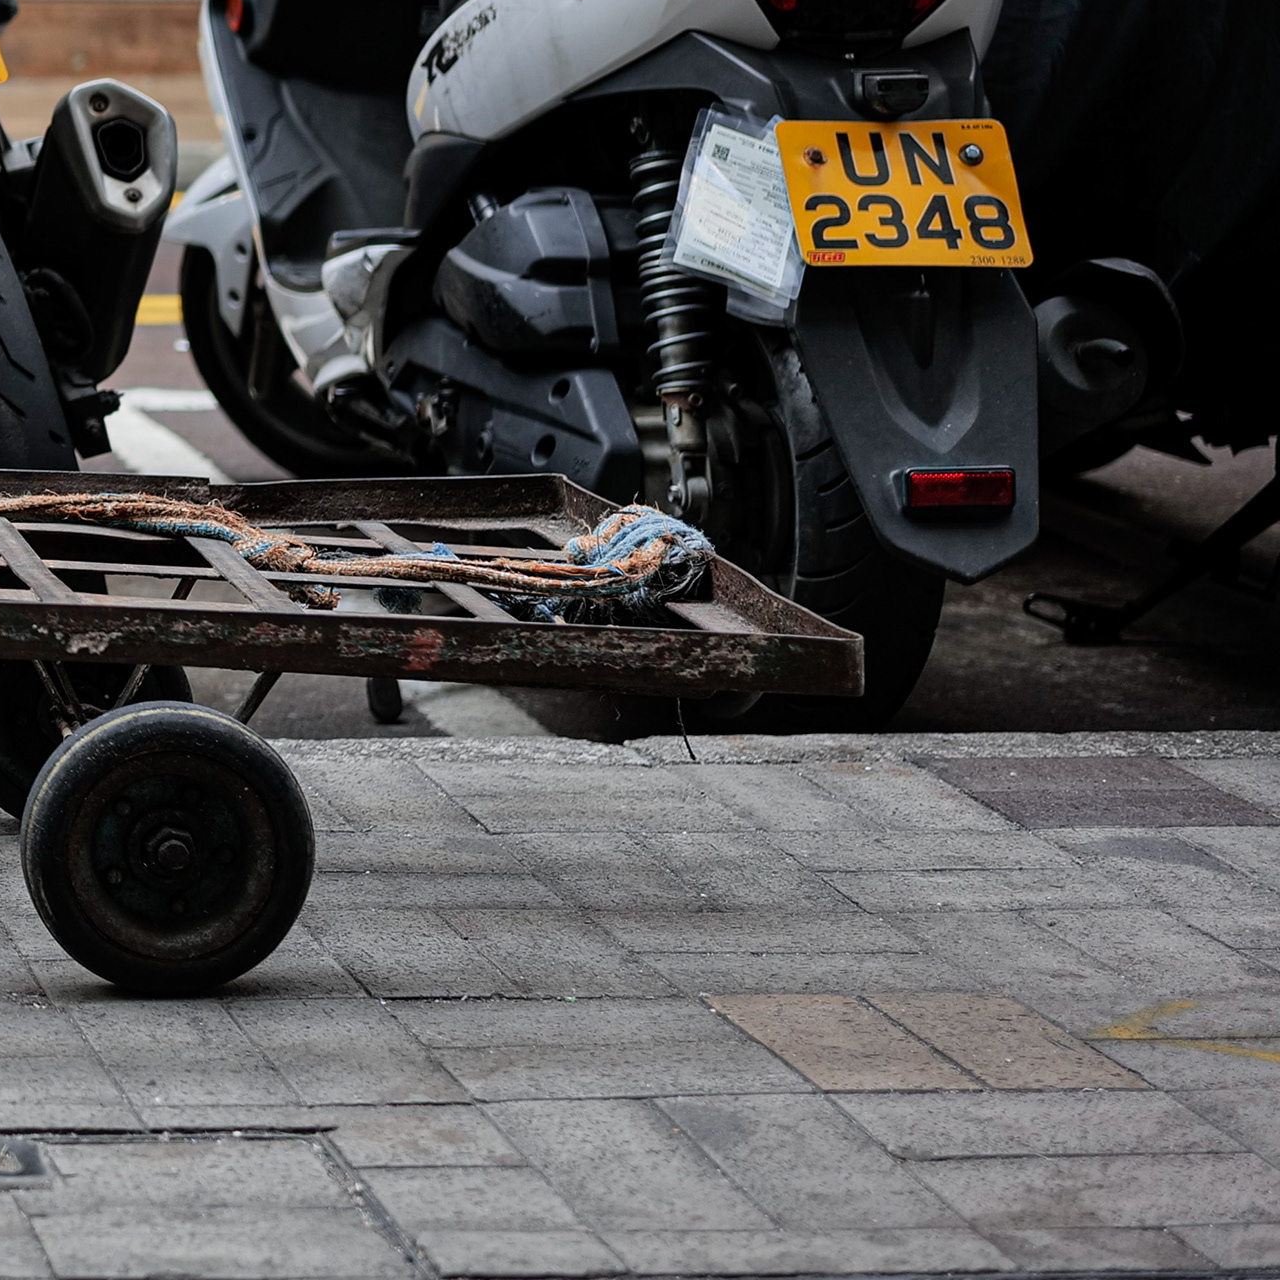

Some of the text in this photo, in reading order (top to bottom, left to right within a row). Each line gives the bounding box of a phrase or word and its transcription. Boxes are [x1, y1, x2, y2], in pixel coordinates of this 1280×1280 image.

[835, 132, 956, 187] UN
[804, 194, 1016, 250] 2348
[970, 255, 1027, 266] 2300 1288
